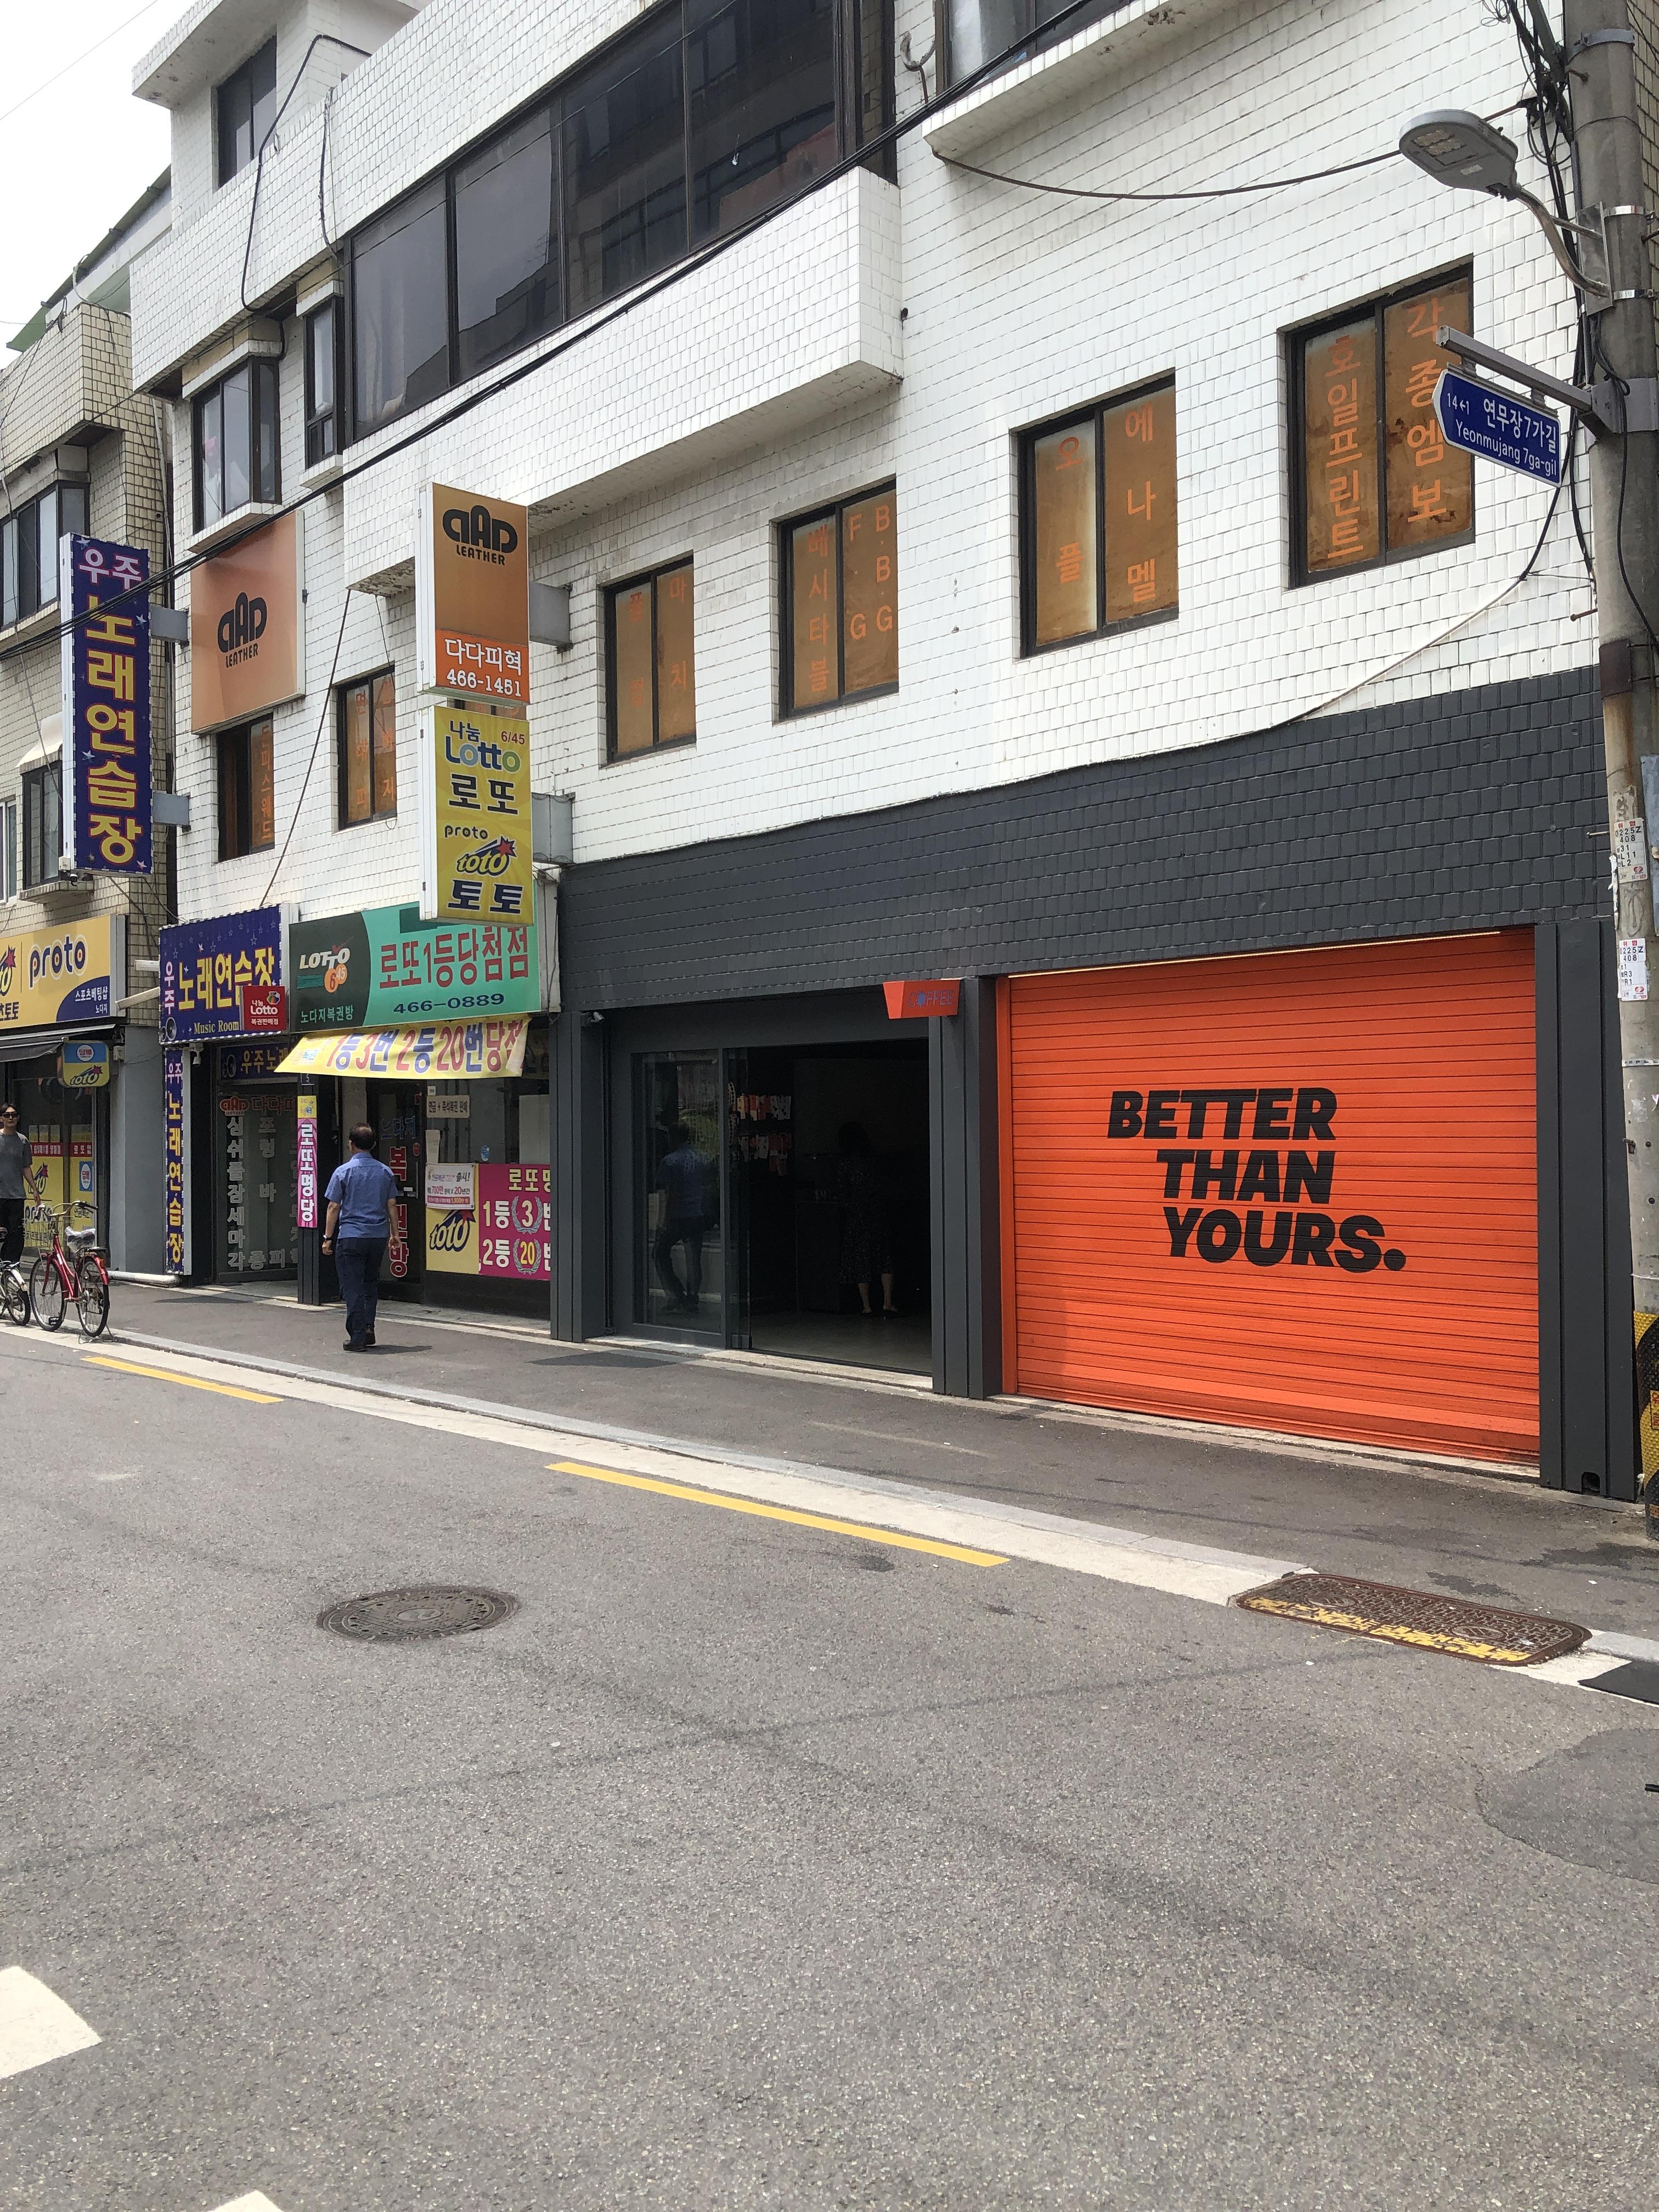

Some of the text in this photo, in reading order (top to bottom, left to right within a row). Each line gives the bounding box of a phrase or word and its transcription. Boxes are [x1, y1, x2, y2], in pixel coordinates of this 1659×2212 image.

[1483, 398, 1556, 454] 연무장7가길
[1455, 419, 1557, 477] Yeonmujang 7ga-gil
[79, 549, 142, 590] 우주
[456, 544, 505, 566] LEATHER
[225, 643, 259, 668] LEATHER
[444, 639, 522, 676] 다다피혁
[446, 668, 522, 697] 466-1451
[86, 595, 143, 864] 노래연습장
[450, 720, 526, 745] 나눔 6/45
[445, 736, 521, 773] Lotto
[449, 774, 518, 815] 로또
[444, 825, 488, 840] proto
[1620, 835, 1636, 844] 408
[456, 851, 510, 876] toto
[448, 879, 523, 915] 토토
[29, 935, 87, 989] proto
[299, 947, 351, 969] LOTTO
[164, 961, 175, 1015] 우주
[393, 993, 505, 1014] 466-0889
[908, 989, 954, 1008] COFFEE
[95, 1003, 108, 1014] 노다지
[250, 1005, 278, 1014] Lotto
[300, 1005, 354, 1024] 노다지복권방
[193, 1019, 239, 1035] Music Room
[1108, 1087, 1337, 1141] BETTER
[168, 1092, 183, 1263] 노래연습장
[300, 1124, 314, 1222] 로또명당
[1156, 1149, 1336, 1205] THAN
[521, 1200, 533, 1227] 3
[429, 1216, 471, 1252] toto
[1163, 1206, 1407, 1273] YOURS.
[520, 1241, 535, 1265] 20
